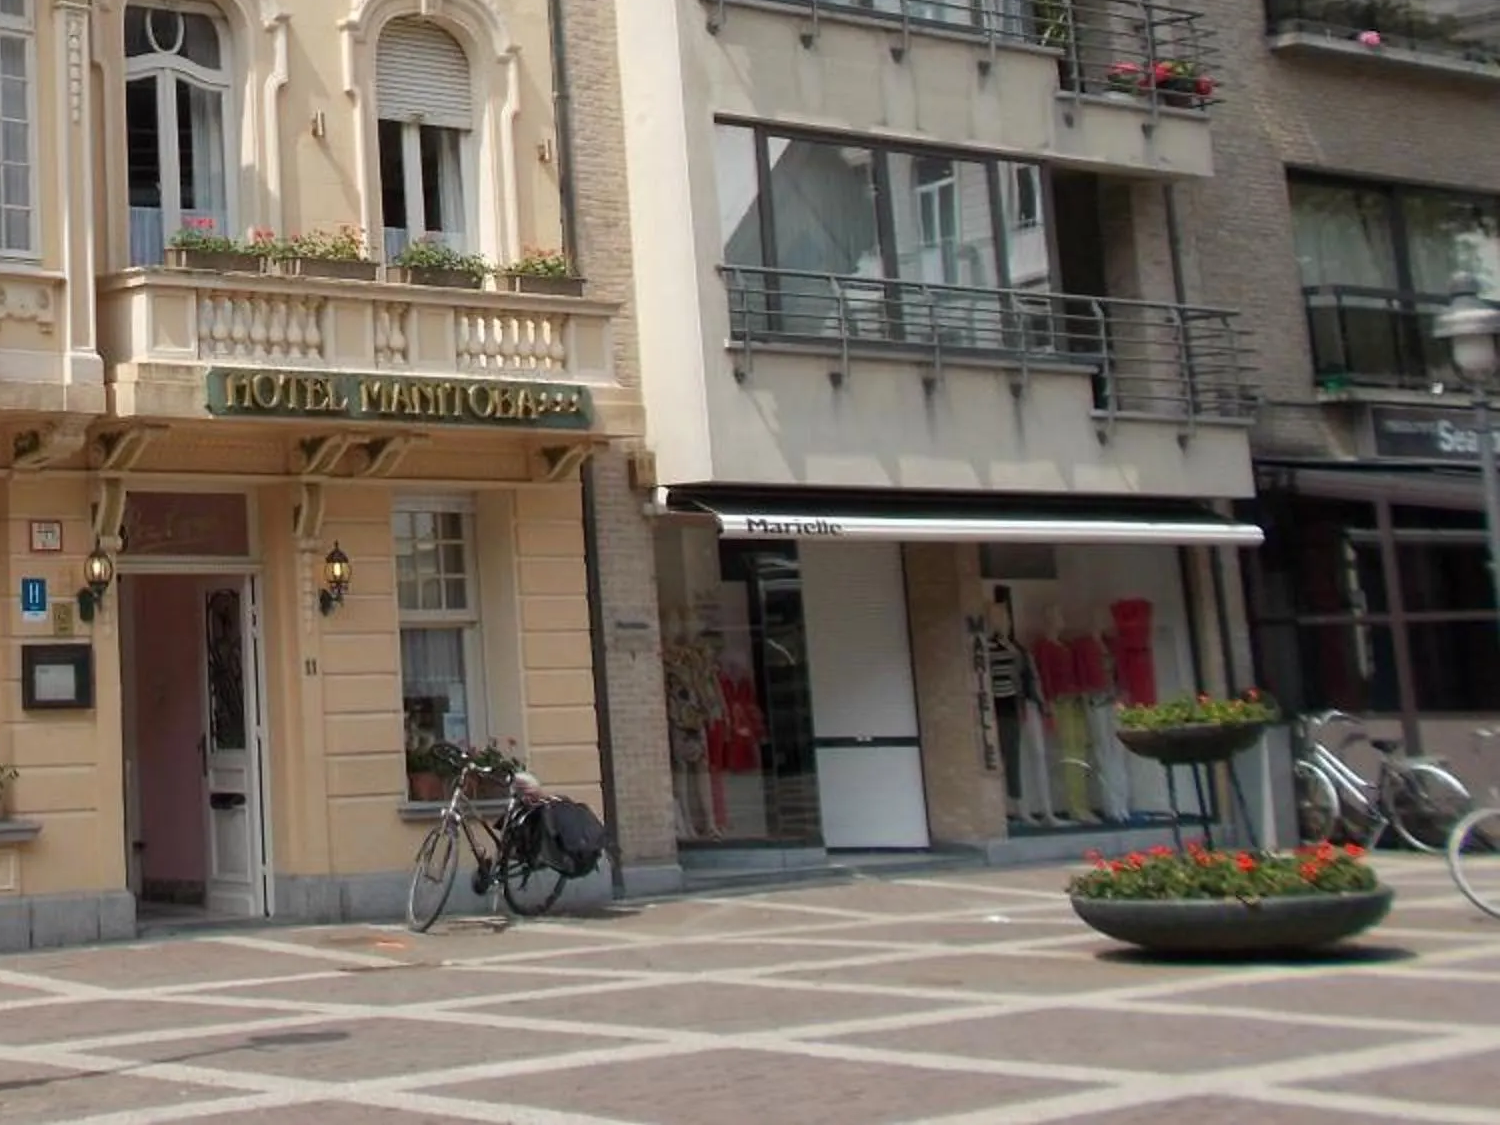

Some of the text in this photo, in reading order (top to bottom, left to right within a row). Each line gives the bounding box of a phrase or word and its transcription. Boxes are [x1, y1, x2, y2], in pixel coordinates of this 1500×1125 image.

[226, 372, 538, 419] HOTEL MANITOBA
[746, 517, 842, 536] Marielle
